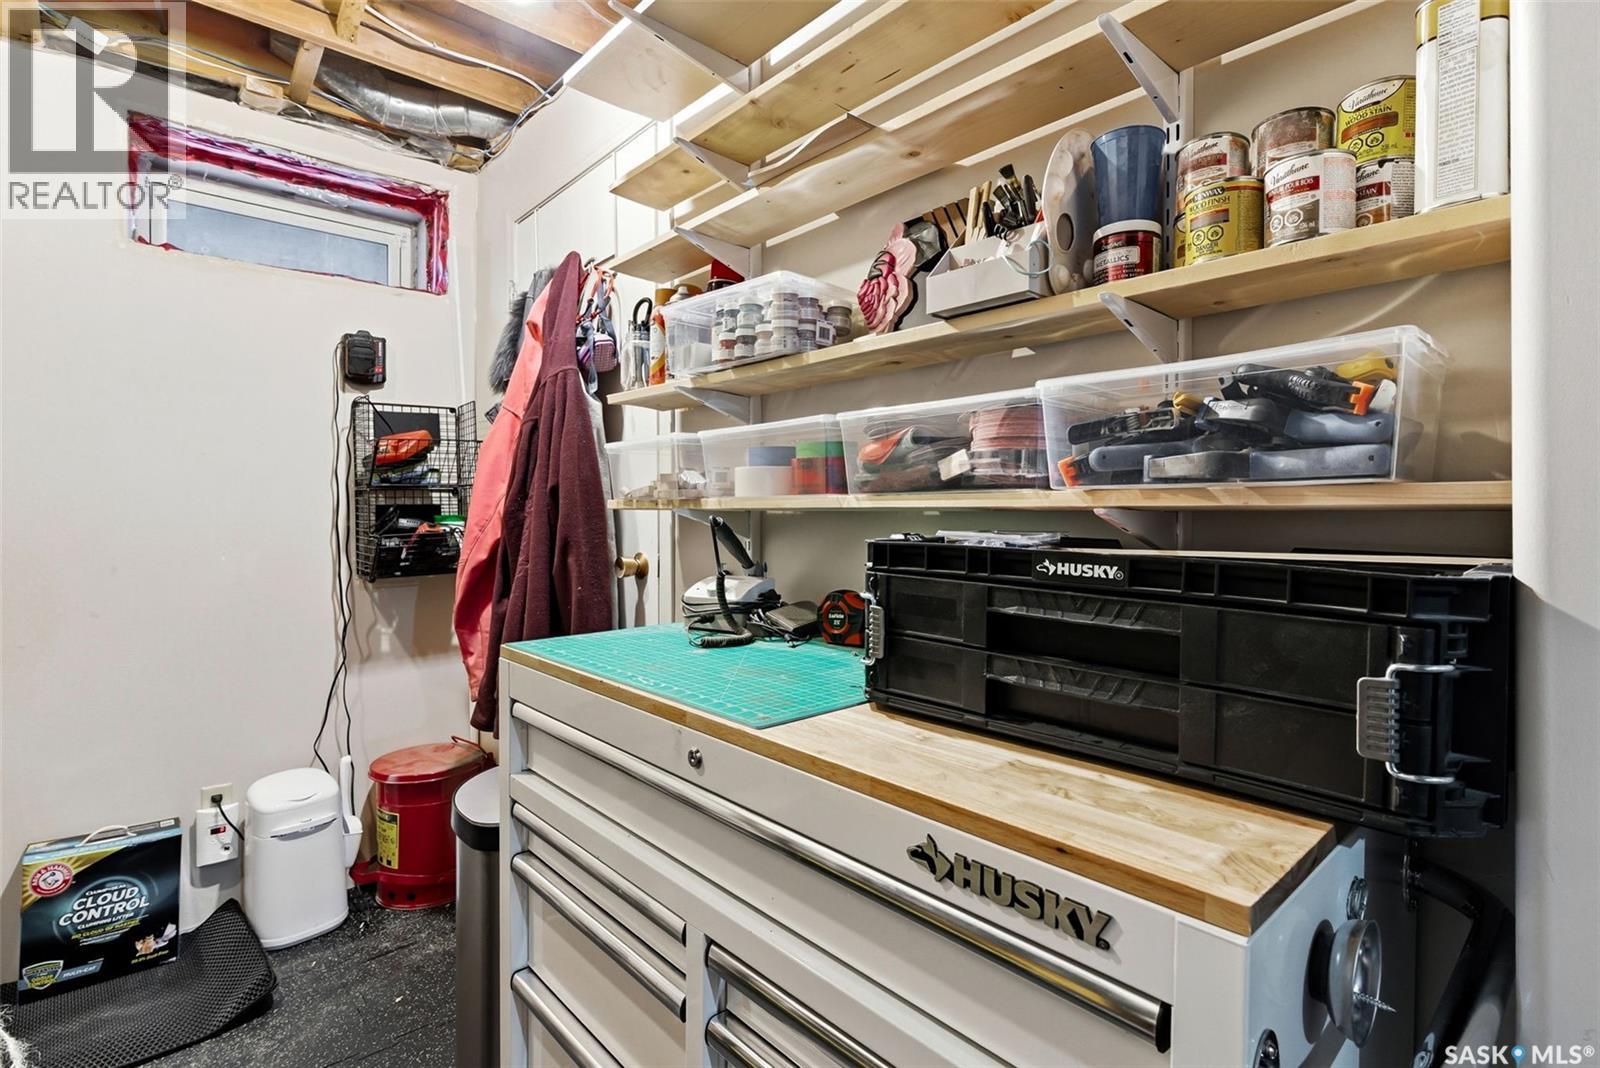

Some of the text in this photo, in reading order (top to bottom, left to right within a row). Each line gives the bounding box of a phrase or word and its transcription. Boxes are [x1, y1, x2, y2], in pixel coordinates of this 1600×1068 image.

[1345, 111, 1368, 126] WOOD
[1369, 104, 1393, 115] STAIN
[1270, 162, 1310, 186] Varathane
[1208, 195, 1231, 206] FINISH
[1096, 254, 1130, 269] METALLICS
[73, 886, 140, 911] CLOUD
[58, 896, 150, 927] CONTROL
[112, 912, 135, 922] LITTER
[62, 965, 98, 978] MULTI-CAT
